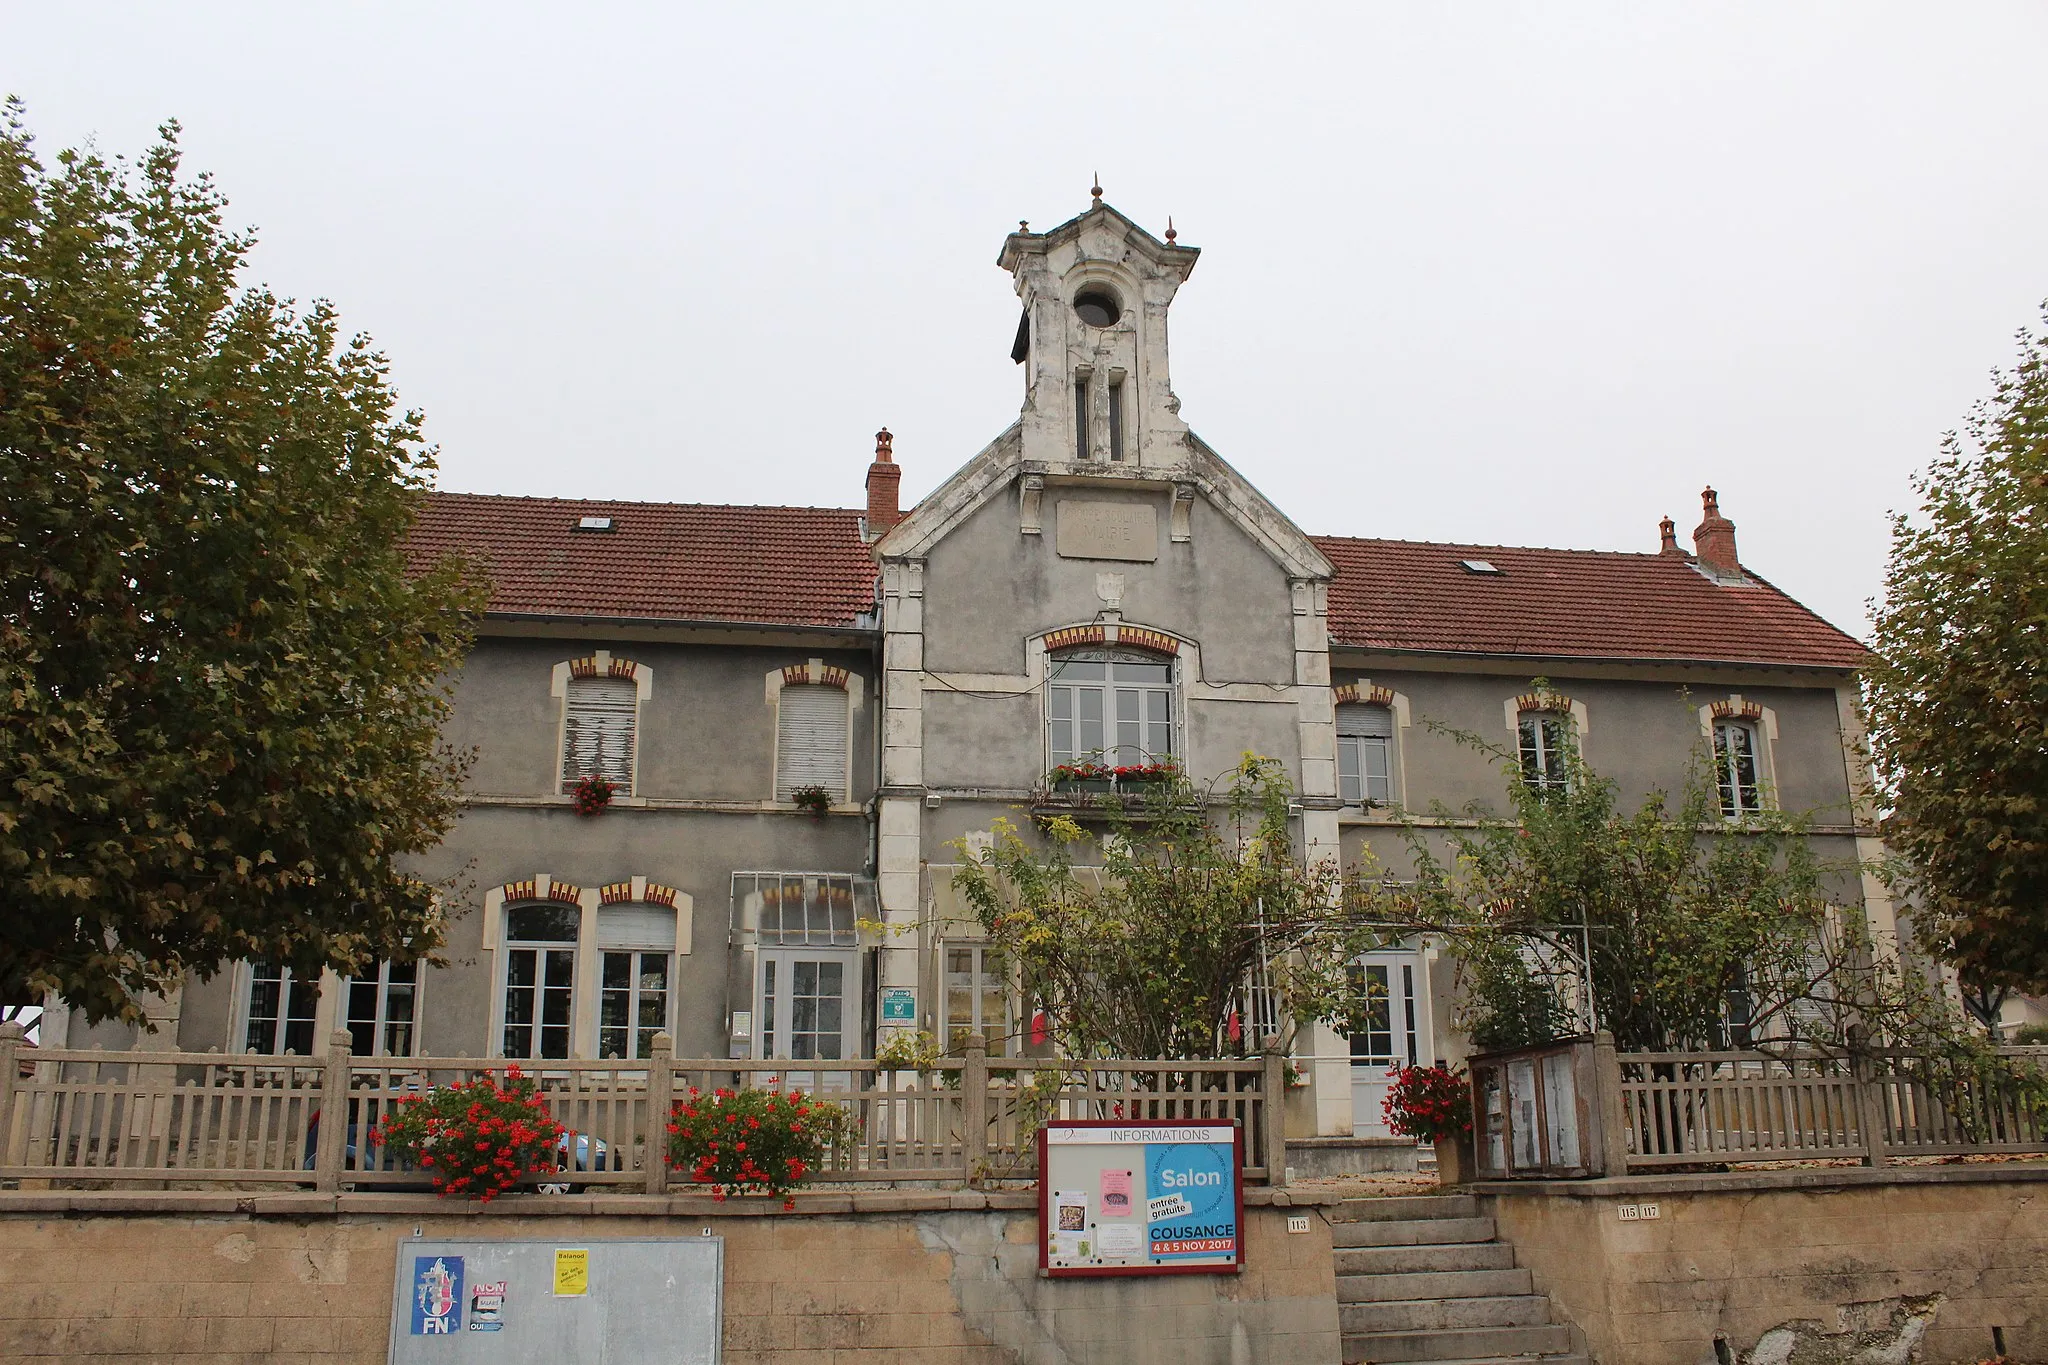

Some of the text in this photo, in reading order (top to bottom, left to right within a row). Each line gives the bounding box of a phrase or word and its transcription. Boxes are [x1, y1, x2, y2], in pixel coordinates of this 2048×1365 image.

[1105, 510, 1149, 524] SCOLAIRE
[1083, 525, 1131, 541] MAIRIE
[1110, 1129, 1210, 1142] INFORMATIONS
[1161, 1168, 1221, 1188] Salon
[1150, 1196, 1178, 1209] entrée
[1152, 1204, 1185, 1219] gratuite
[1621, 1206, 1656, 1218] 115 117
[1291, 1220, 1306, 1230] 113
[1151, 1225, 1234, 1239] COUSANCE
[1153, 1239, 1232, 1252] 4 & 5 NOV 2017
[476, 1282, 505, 1293] NON
[422, 1316, 449, 1334] FN
